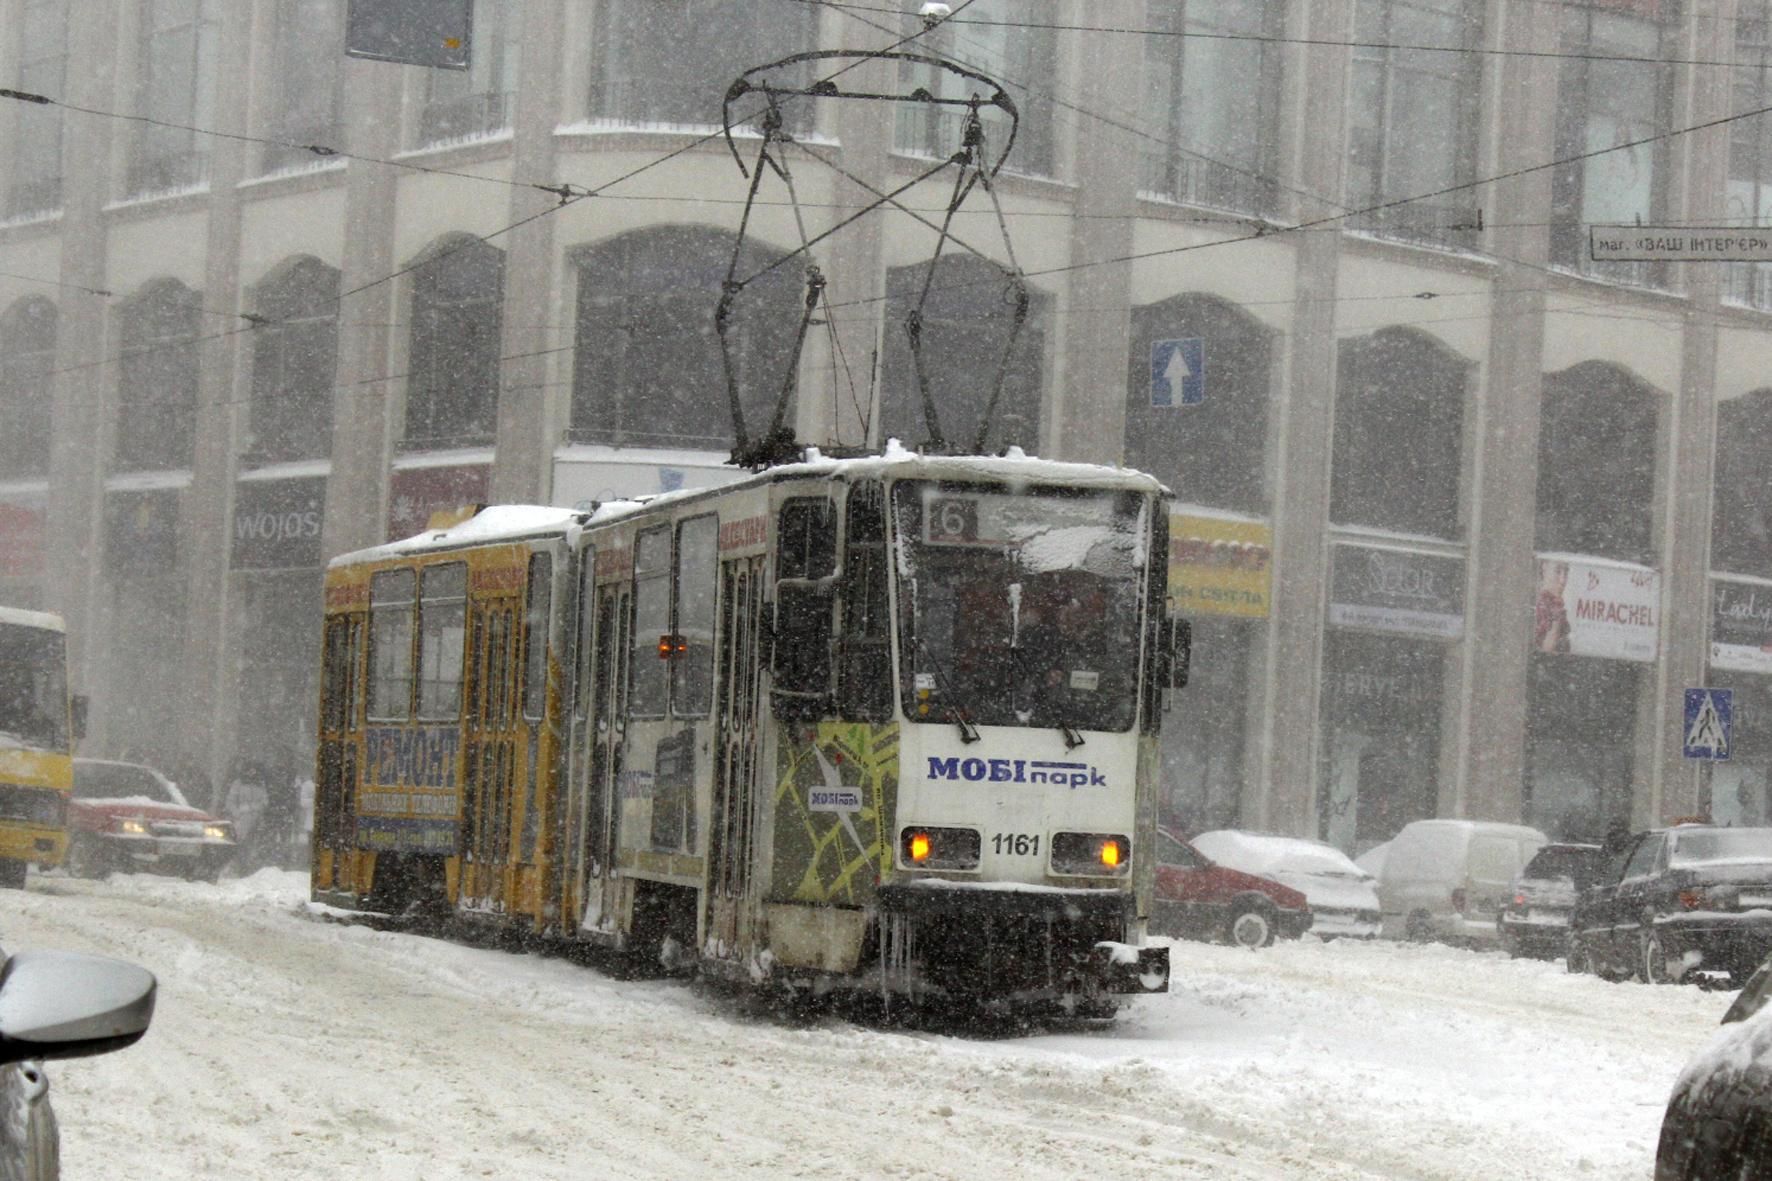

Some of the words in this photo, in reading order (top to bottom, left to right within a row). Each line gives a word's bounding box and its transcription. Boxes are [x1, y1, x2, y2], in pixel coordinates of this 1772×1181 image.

[941, 501, 964, 535] 6
[1575, 598, 1655, 626] MIRACHEL
[991, 832, 1040, 857] 1161
